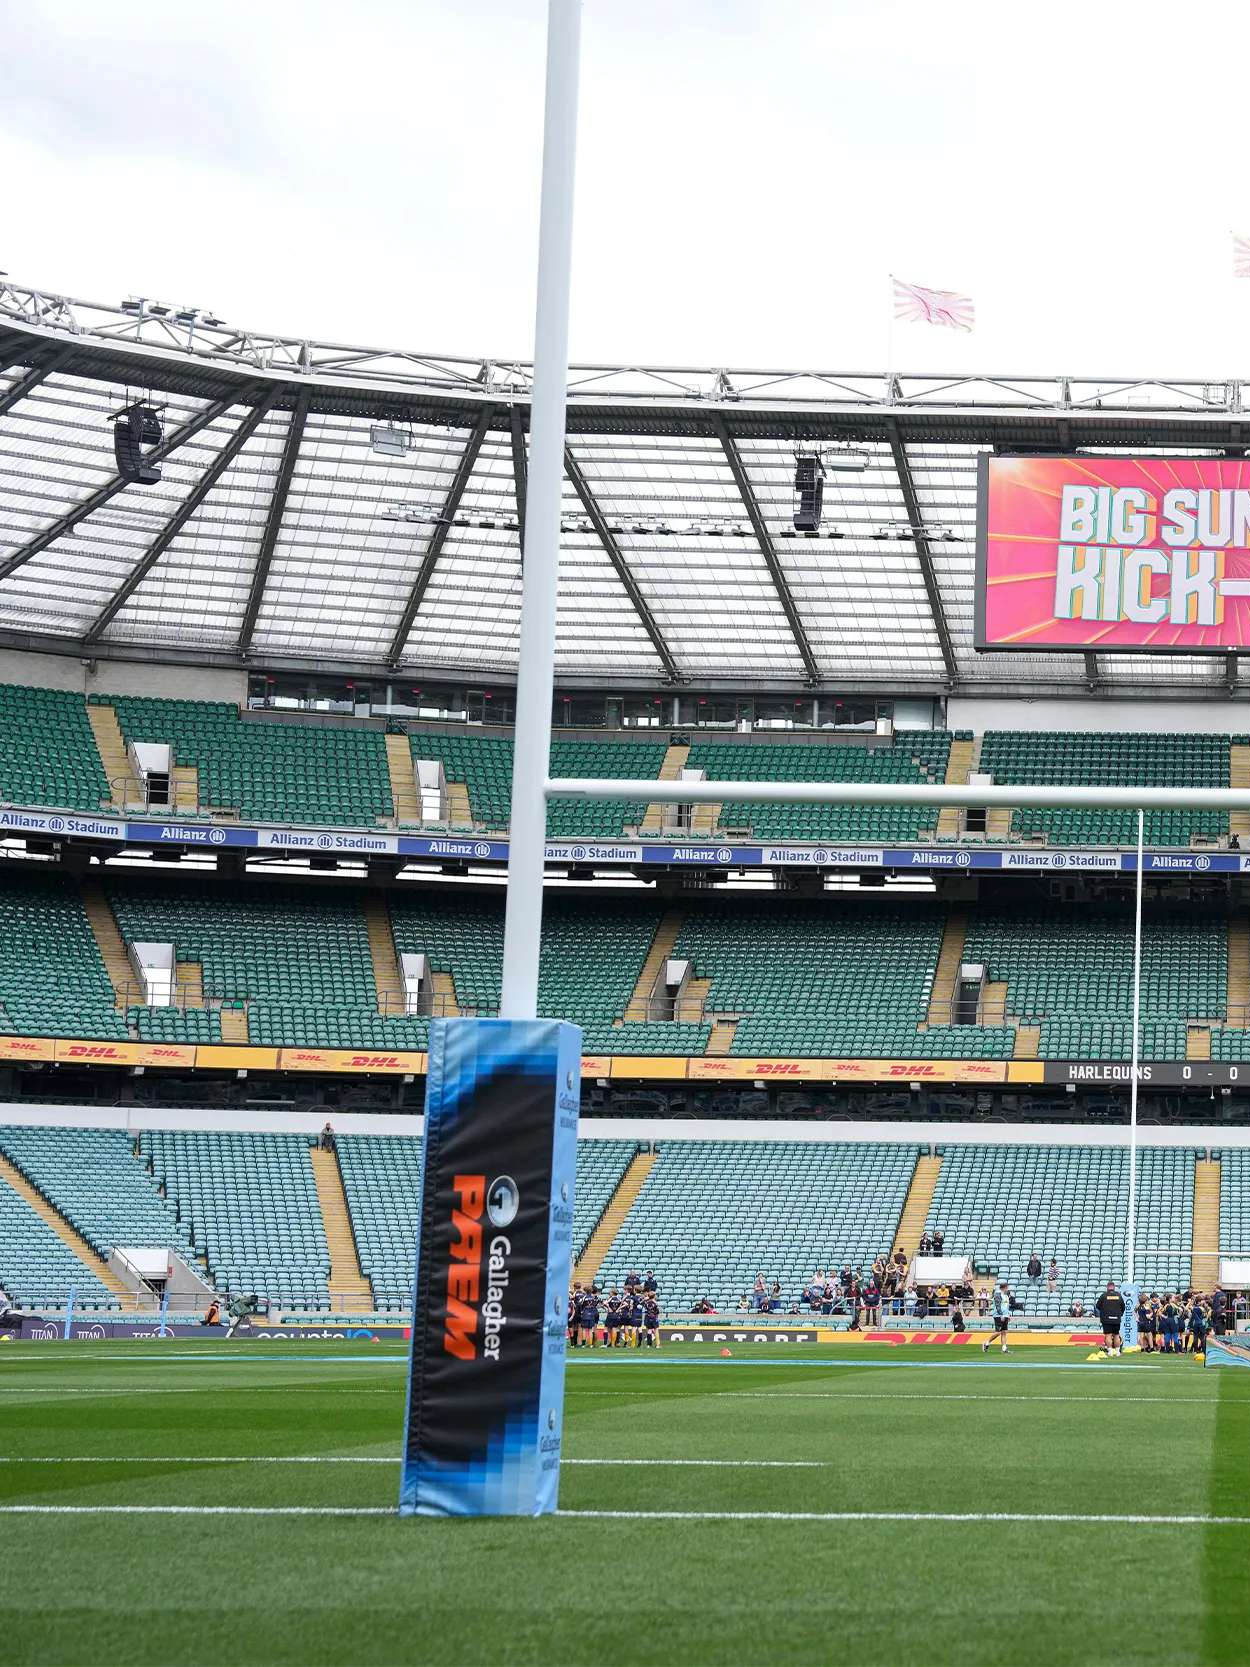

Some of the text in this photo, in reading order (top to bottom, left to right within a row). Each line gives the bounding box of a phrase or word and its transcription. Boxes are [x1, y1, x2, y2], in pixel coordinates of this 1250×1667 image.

[1059, 485, 1157, 545] BIG
[0, 813, 119, 836] Allianz Stadium
[160, 827, 207, 842] Allianz
[270, 833, 387, 851] Allianz Stadium
[429, 841, 472, 855] Allianz
[544, 847, 637, 859] ianz Stadium
[673, 848, 714, 861] Allianz
[769, 850, 879, 863] Allianz Stadium
[912, 852, 953, 865] Allianz
[1008, 854, 1117, 867] Allianz Stadium
[1152, 855, 1193, 868] Allianz
[10, 1042, 38, 1051] DHL
[69, 1045, 118, 1059] DHL
[151, 1049, 180, 1058] DHL
[296, 1054, 323, 1062] DHL
[351, 1055, 402, 1068] DHL
[703, 1063, 728, 1071] DHL
[756, 1064, 802, 1074] DHL
[890, 1065, 936, 1076] DHL
[967, 1065, 992, 1073] DHL
[1069, 1065, 1152, 1080] HARLEQUINS
[1183, 1066, 1192, 1080] 0
[1229, 1066, 1238, 1080] 0
[444, 1175, 486, 1360] PREM
[482, 1236, 511, 1361] Gallagher
[1124, 1299, 1133, 1343] Gallagher
